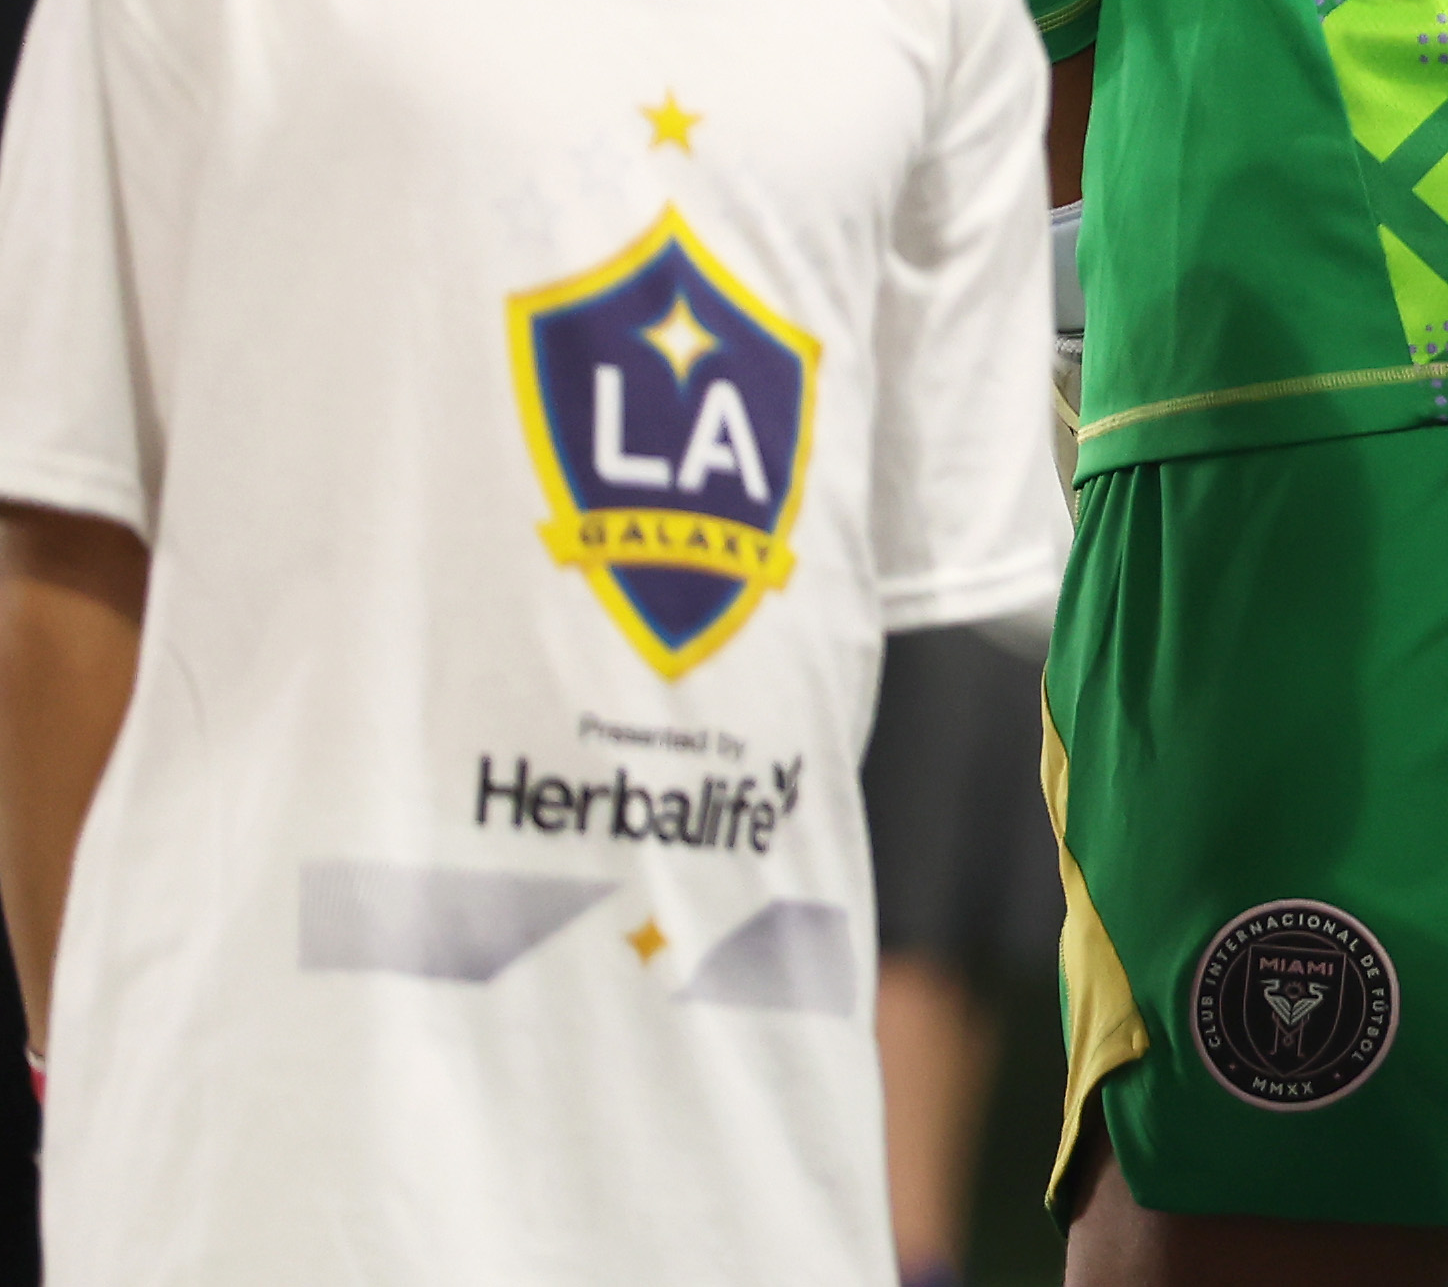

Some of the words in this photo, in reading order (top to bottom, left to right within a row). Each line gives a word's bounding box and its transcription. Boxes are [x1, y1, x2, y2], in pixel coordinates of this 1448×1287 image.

[593, 361, 772, 505] LA
[475, 754, 776, 854] Herbalife
[1205, 913, 1358, 985] INTERNACIONAL
[1258, 957, 1334, 976] MIAMI
[1360, 954, 1381, 978] DE
[1201, 996, 1221, 1048] CLUB
[1253, 1076, 1313, 1096] MMXX
